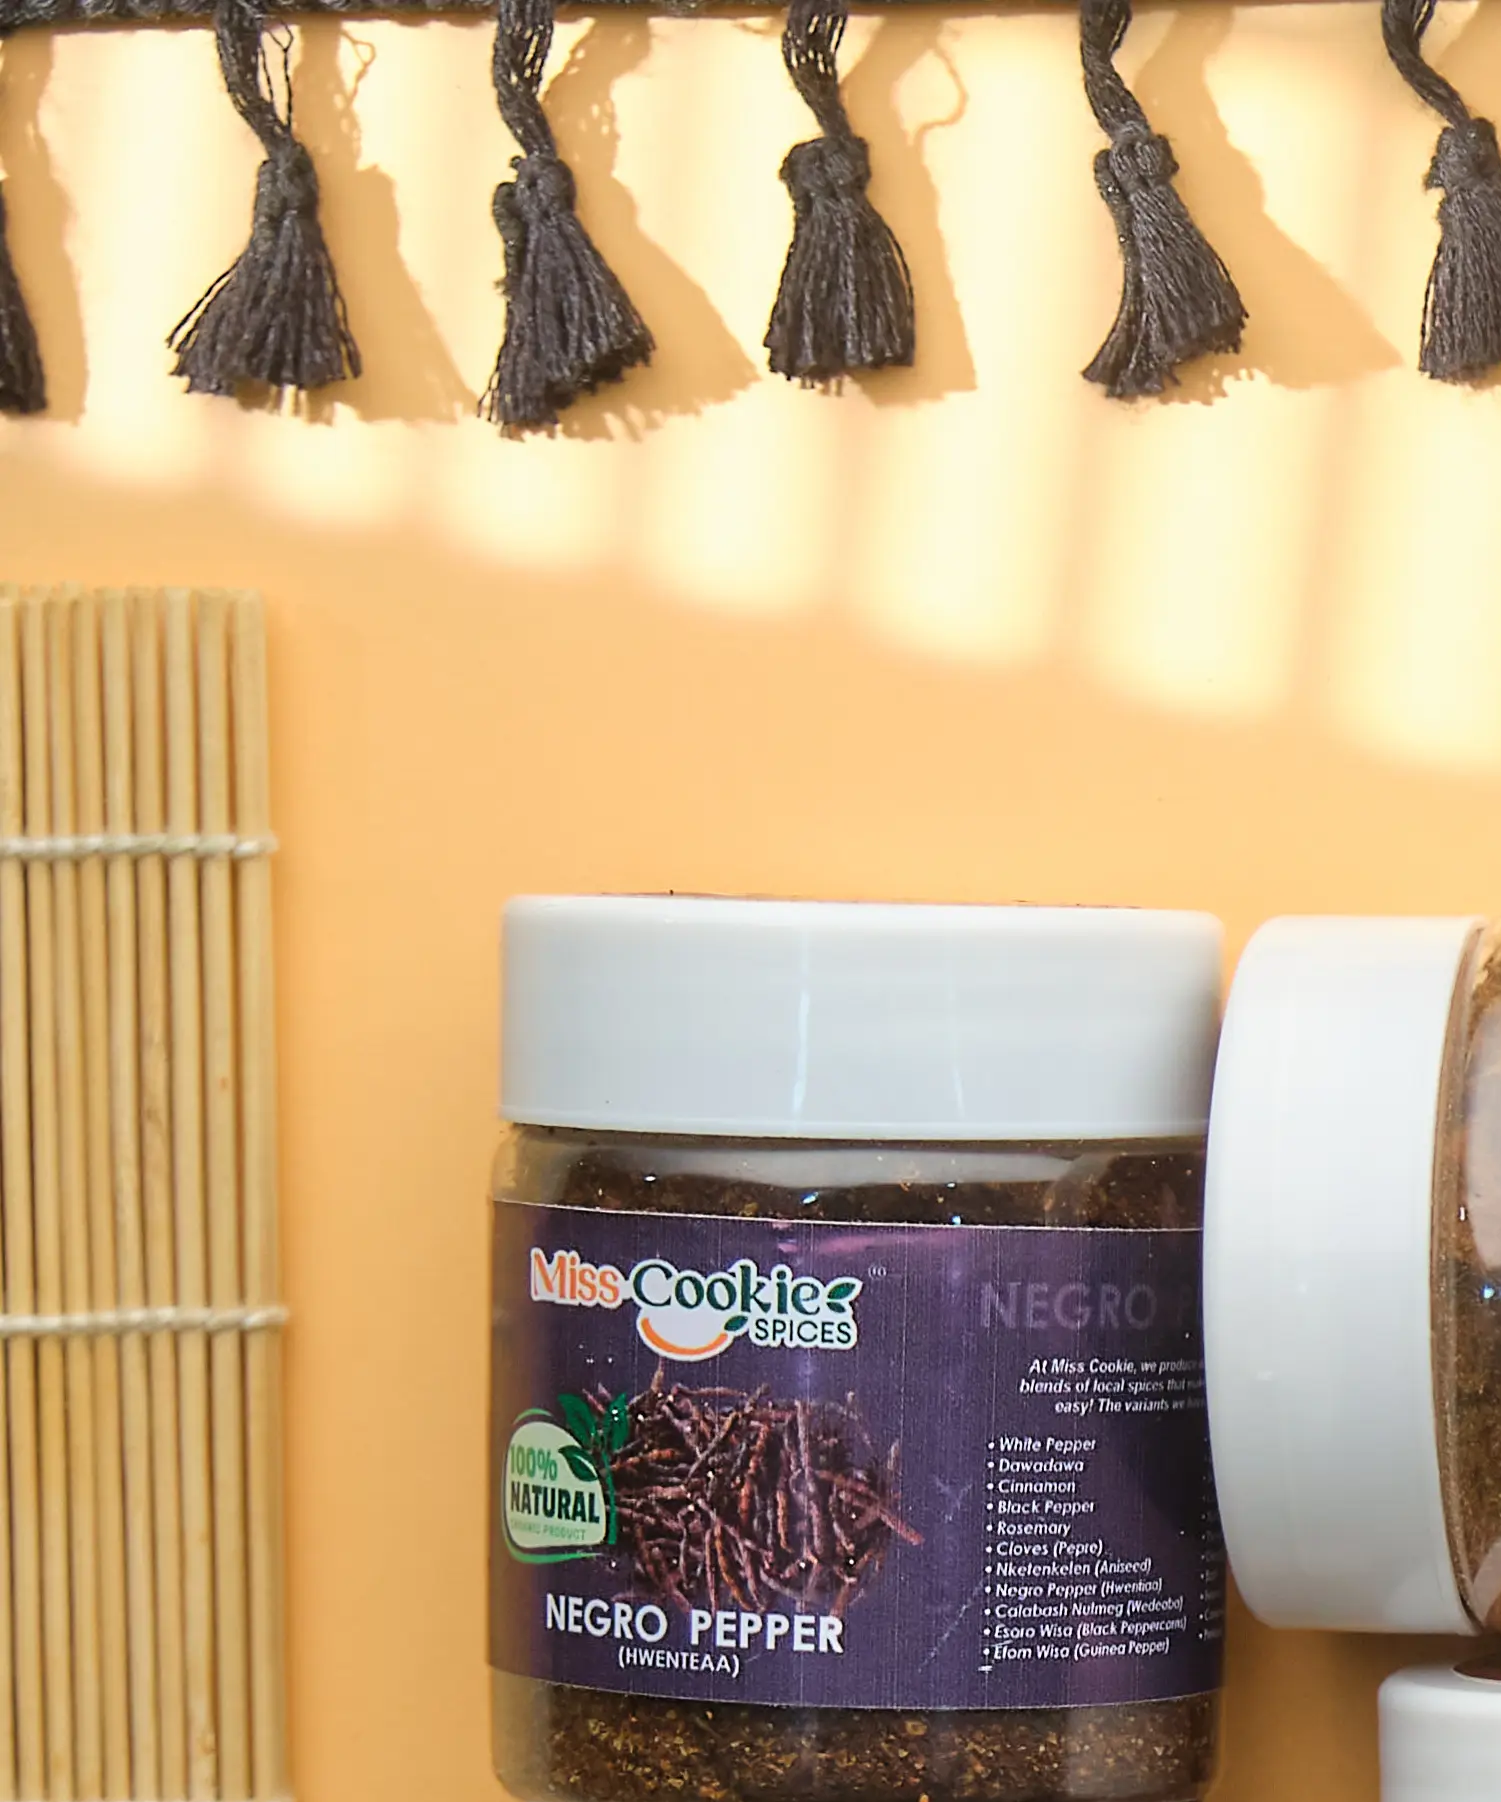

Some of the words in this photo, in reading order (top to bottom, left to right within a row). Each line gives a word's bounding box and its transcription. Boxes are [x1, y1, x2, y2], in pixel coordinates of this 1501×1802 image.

[532, 1251, 620, 1302] Miss
[633, 1264, 820, 1315] Cookie
[755, 1318, 852, 1343] SPICES
[1000, 1437, 1041, 1452] White
[1046, 1437, 1096, 1456] Pepper
[511, 1443, 558, 1481] 100%
[999, 1458, 1084, 1473] Dawadawa
[998, 1480, 1076, 1493] Cinnamon
[511, 1482, 600, 1523] NATURAL
[998, 1500, 1040, 1514] Black
[1045, 1501, 1095, 1517] Pepper
[997, 1521, 1071, 1537] Rosemary
[996, 1582, 1043, 1600] Negro
[1048, 1581, 1097, 1601] Pepper
[546, 1594, 668, 1642] NEGRO
[690, 1609, 843, 1653] PEPPER
[618, 1646, 739, 1678] (HWENTEAA)
